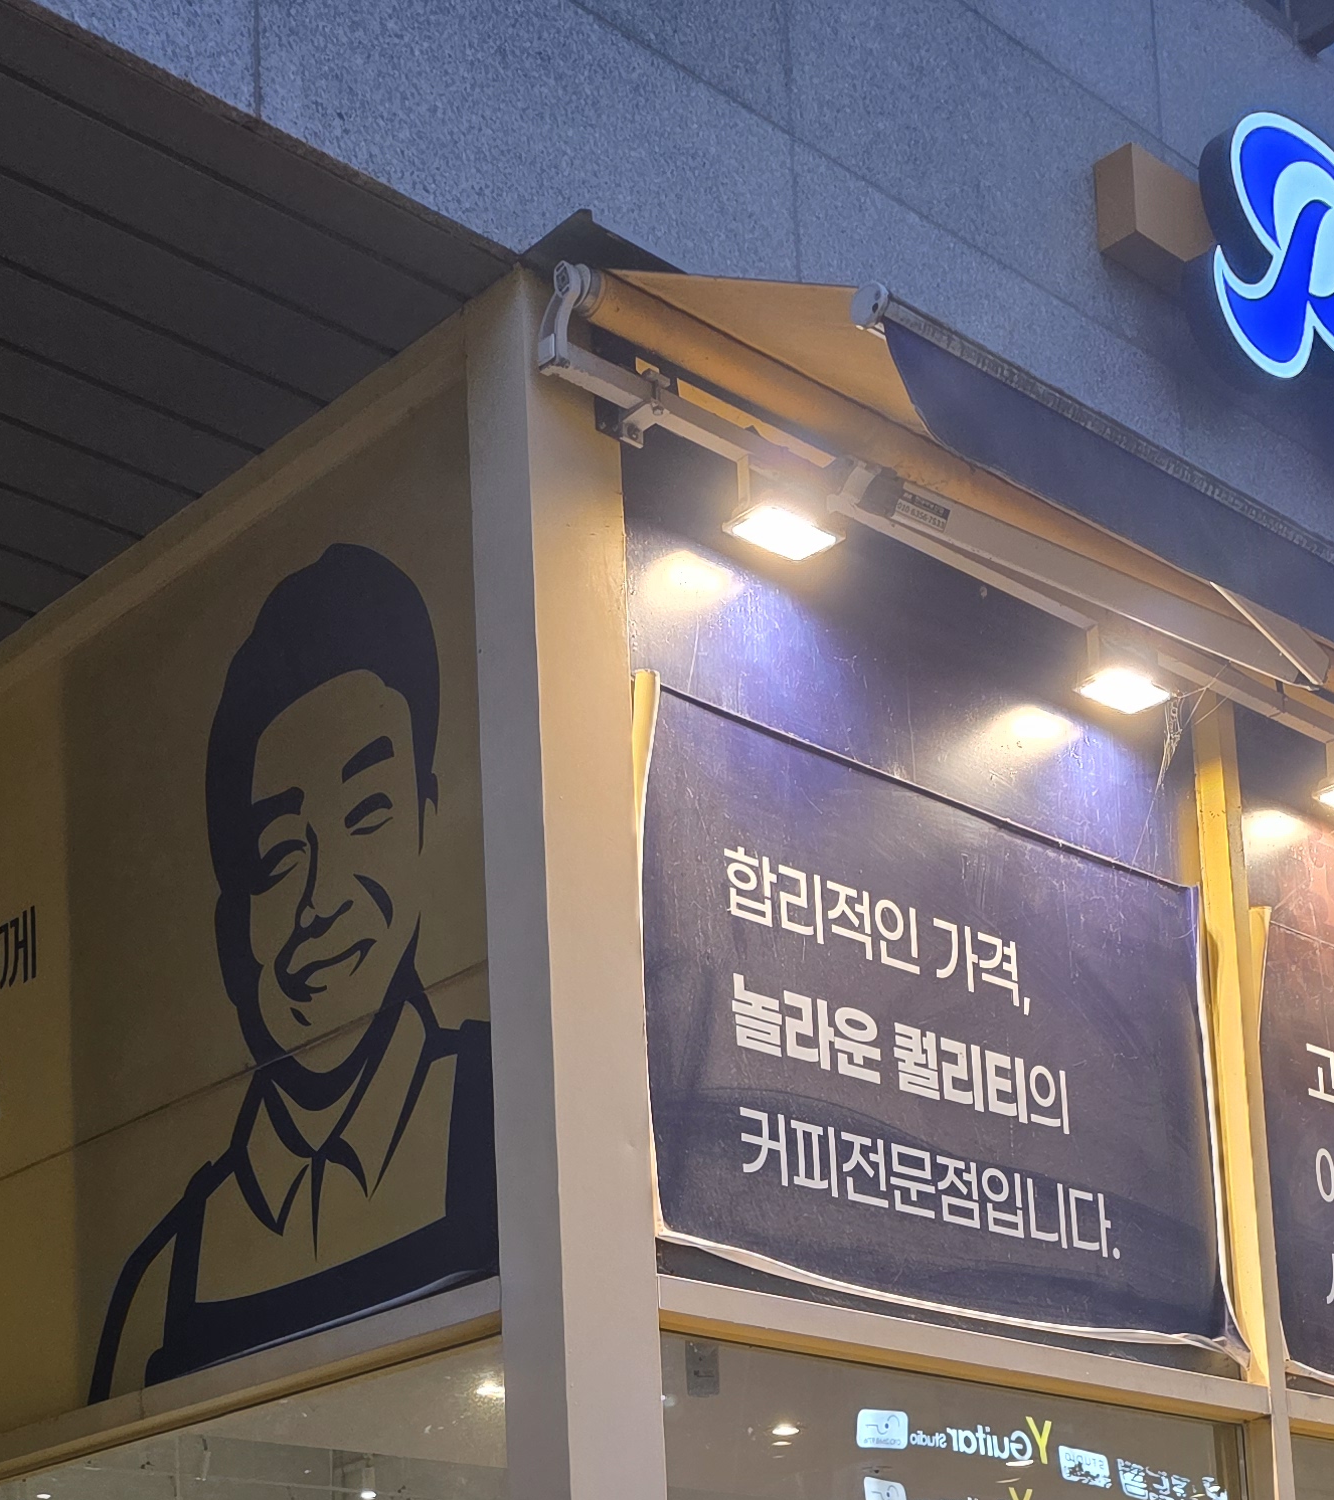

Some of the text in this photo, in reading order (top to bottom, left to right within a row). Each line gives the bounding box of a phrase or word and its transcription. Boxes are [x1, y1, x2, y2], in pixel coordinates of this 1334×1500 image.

[723, 846, 1031, 1018] 합리적인 가격,
[731, 972, 1071, 1135] 놀라운 퀄리티의
[738, 1105, 1122, 1261] 커피전문점입니다.
